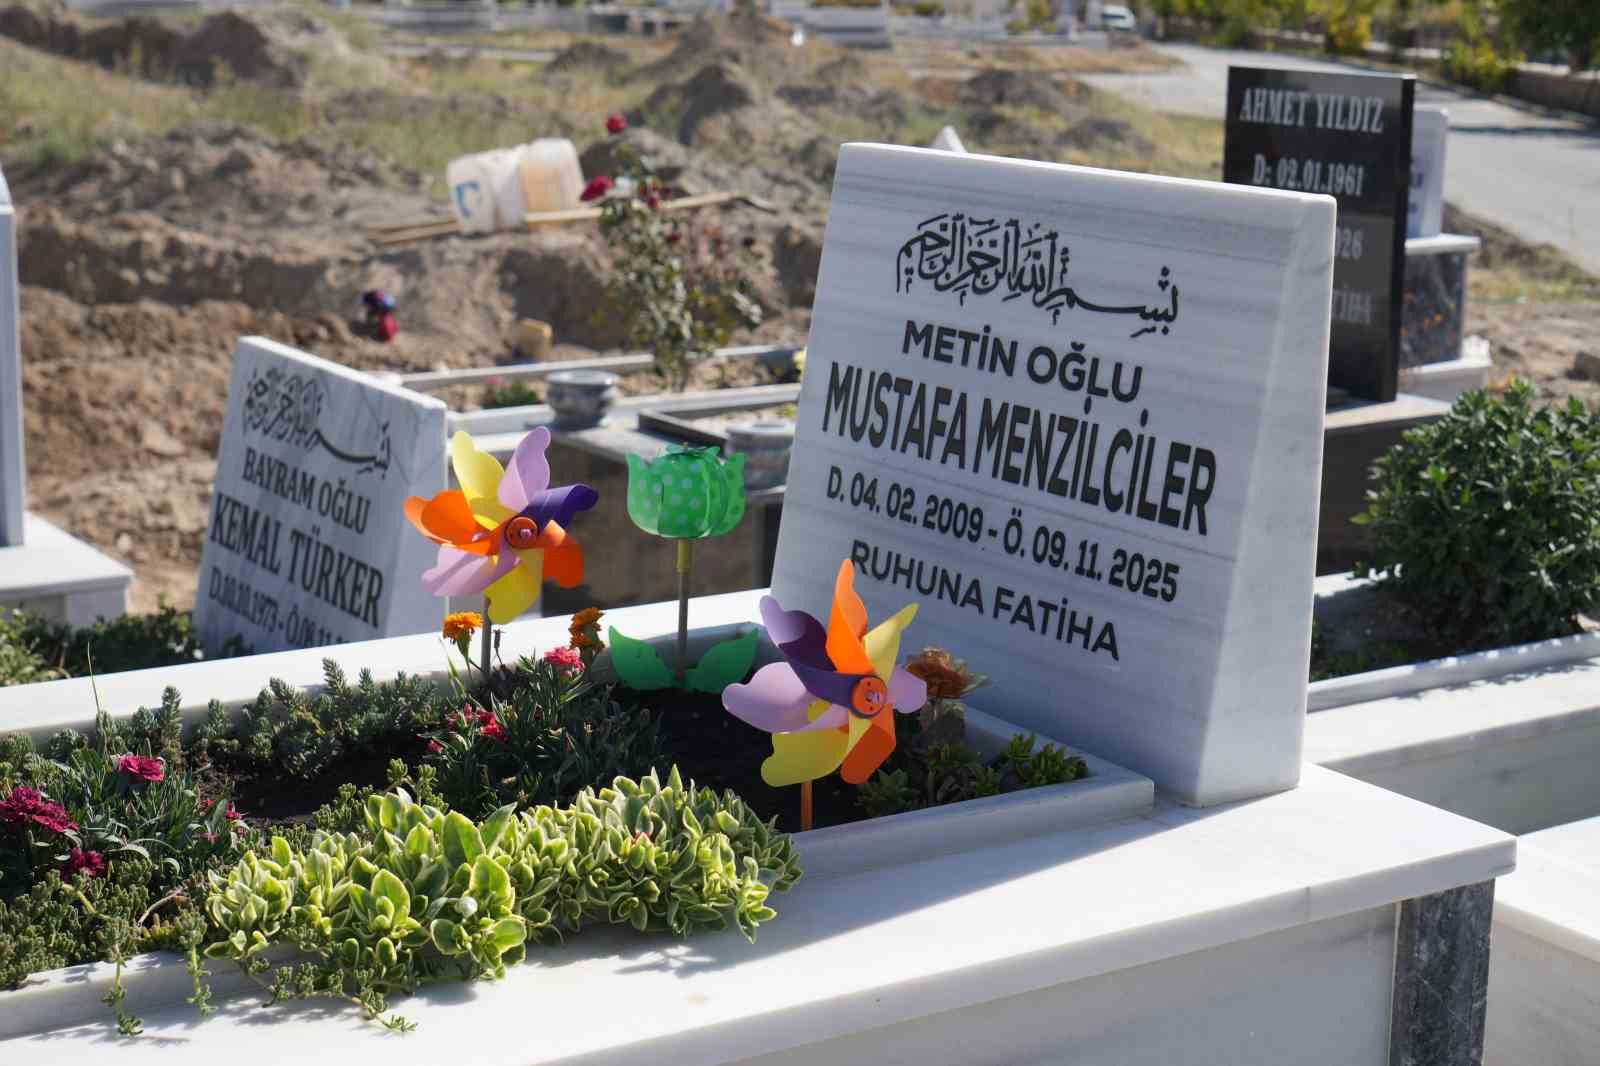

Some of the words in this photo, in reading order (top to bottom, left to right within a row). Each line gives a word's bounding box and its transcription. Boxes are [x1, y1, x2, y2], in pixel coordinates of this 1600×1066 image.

[1239, 87, 1311, 127] AHMET
[1316, 93, 1385, 134] YILDIZ
[1253, 153, 1272, 186] D:
[1276, 156, 1365, 197] 02.01.1961
[902, 319, 1018, 377] METİN
[1027, 341, 1143, 402] OĞLU
[242, 447, 317, 511] BAYRAM
[317, 476, 371, 535] OĞLU
[822, 361, 968, 470] MUSTAFA
[972, 396, 1217, 536] MENZİLCİLER
[210, 493, 282, 576] KEMAL
[287, 526, 384, 628] TÜRKER
[922, 494, 984, 543] 2009
[1108, 548, 1181, 602] 2025
[850, 539, 985, 616] RUHUNA
[992, 585, 1120, 661] FATİHA
